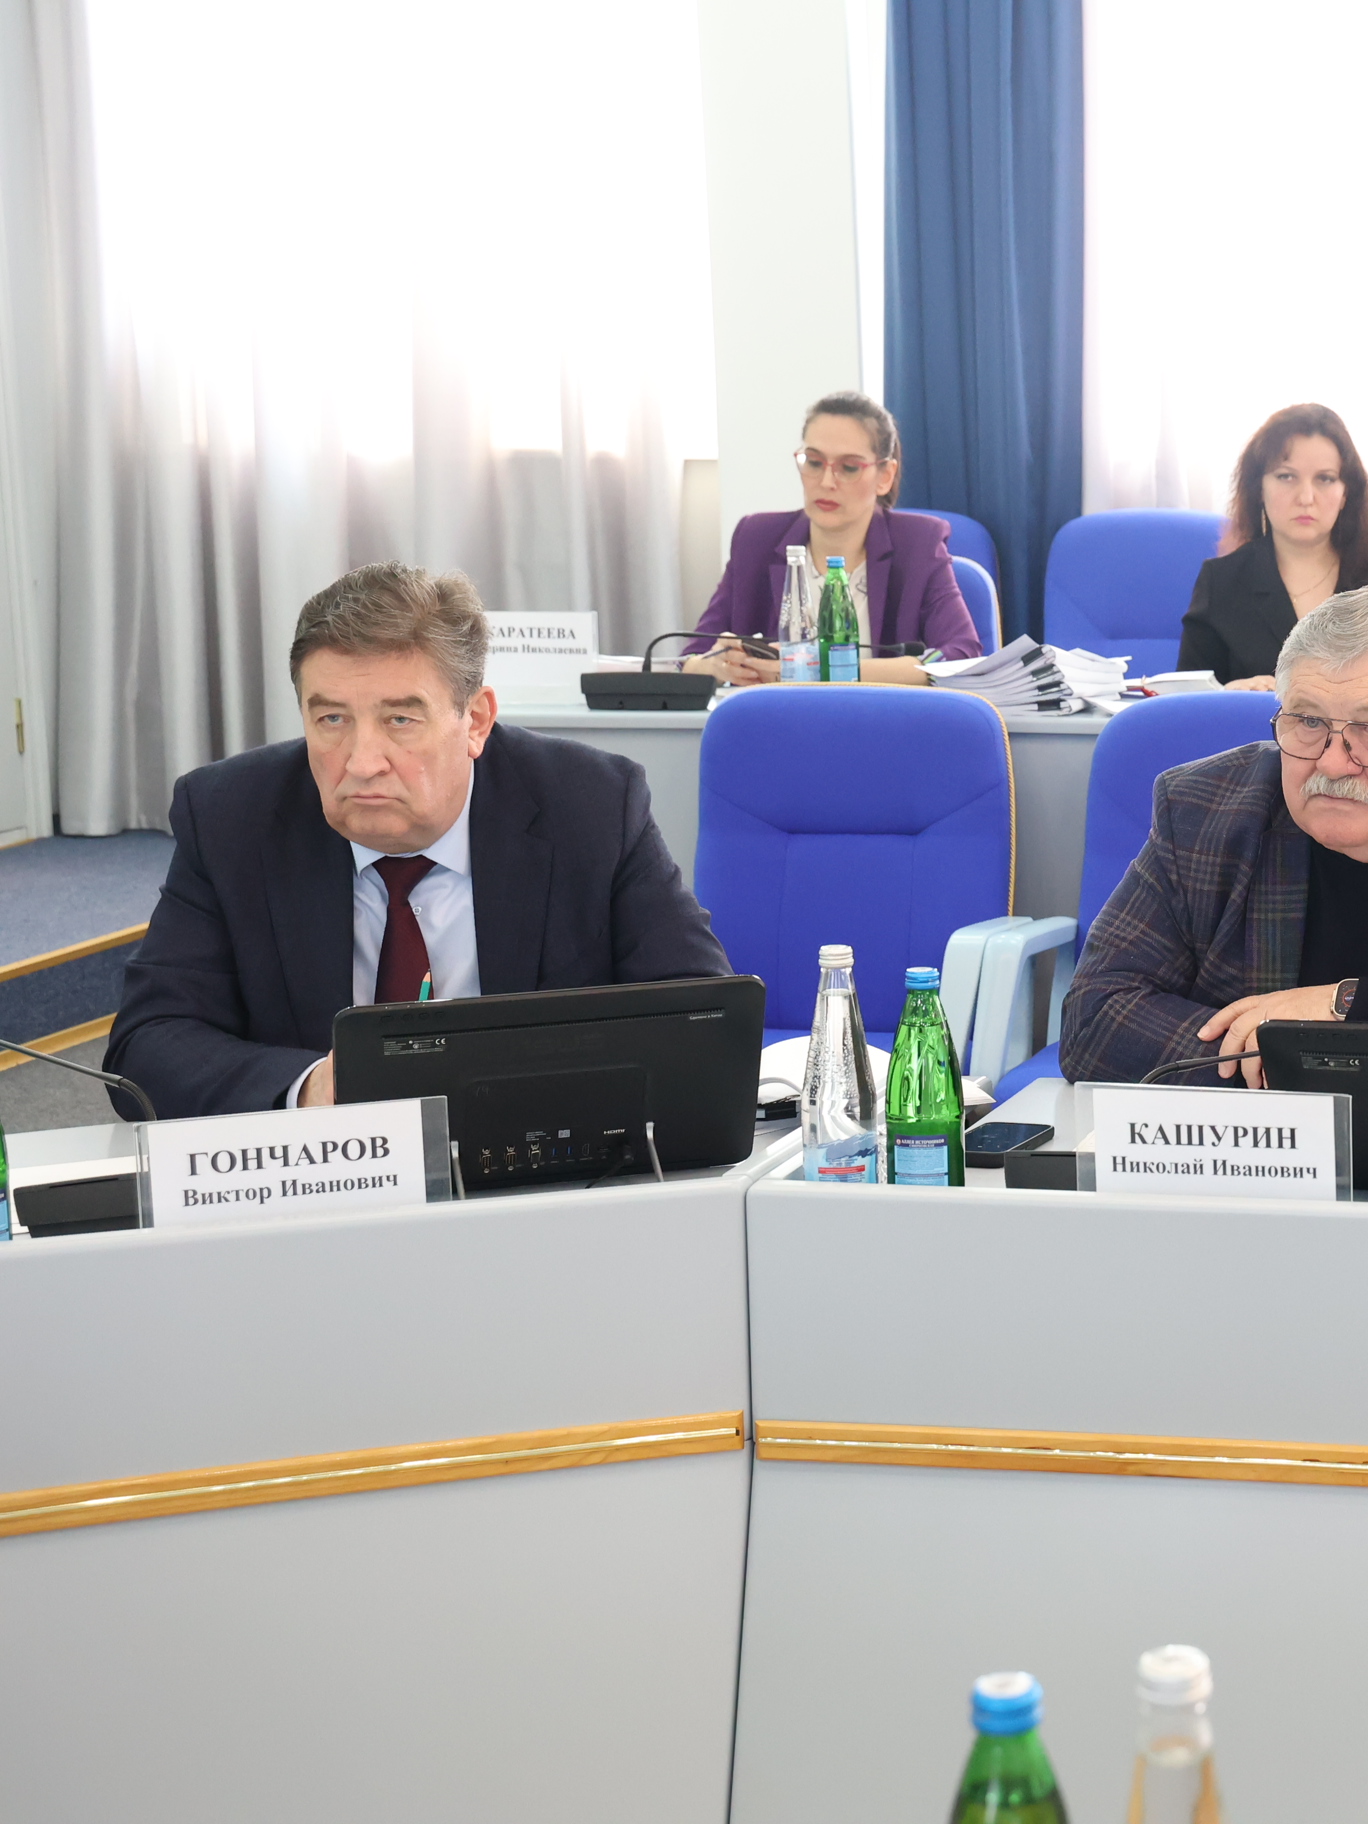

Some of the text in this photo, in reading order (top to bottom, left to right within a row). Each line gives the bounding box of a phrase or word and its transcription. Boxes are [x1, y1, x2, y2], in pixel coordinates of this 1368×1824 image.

[521, 643, 588, 656] Николаевна
[1127, 1122, 1299, 1150] КАШУРИН
[187, 1135, 391, 1177] ГОНЧАРОВ
[1111, 1155, 1318, 1180] Николай Иванович
[182, 1173, 399, 1208] Виктор Иванович
